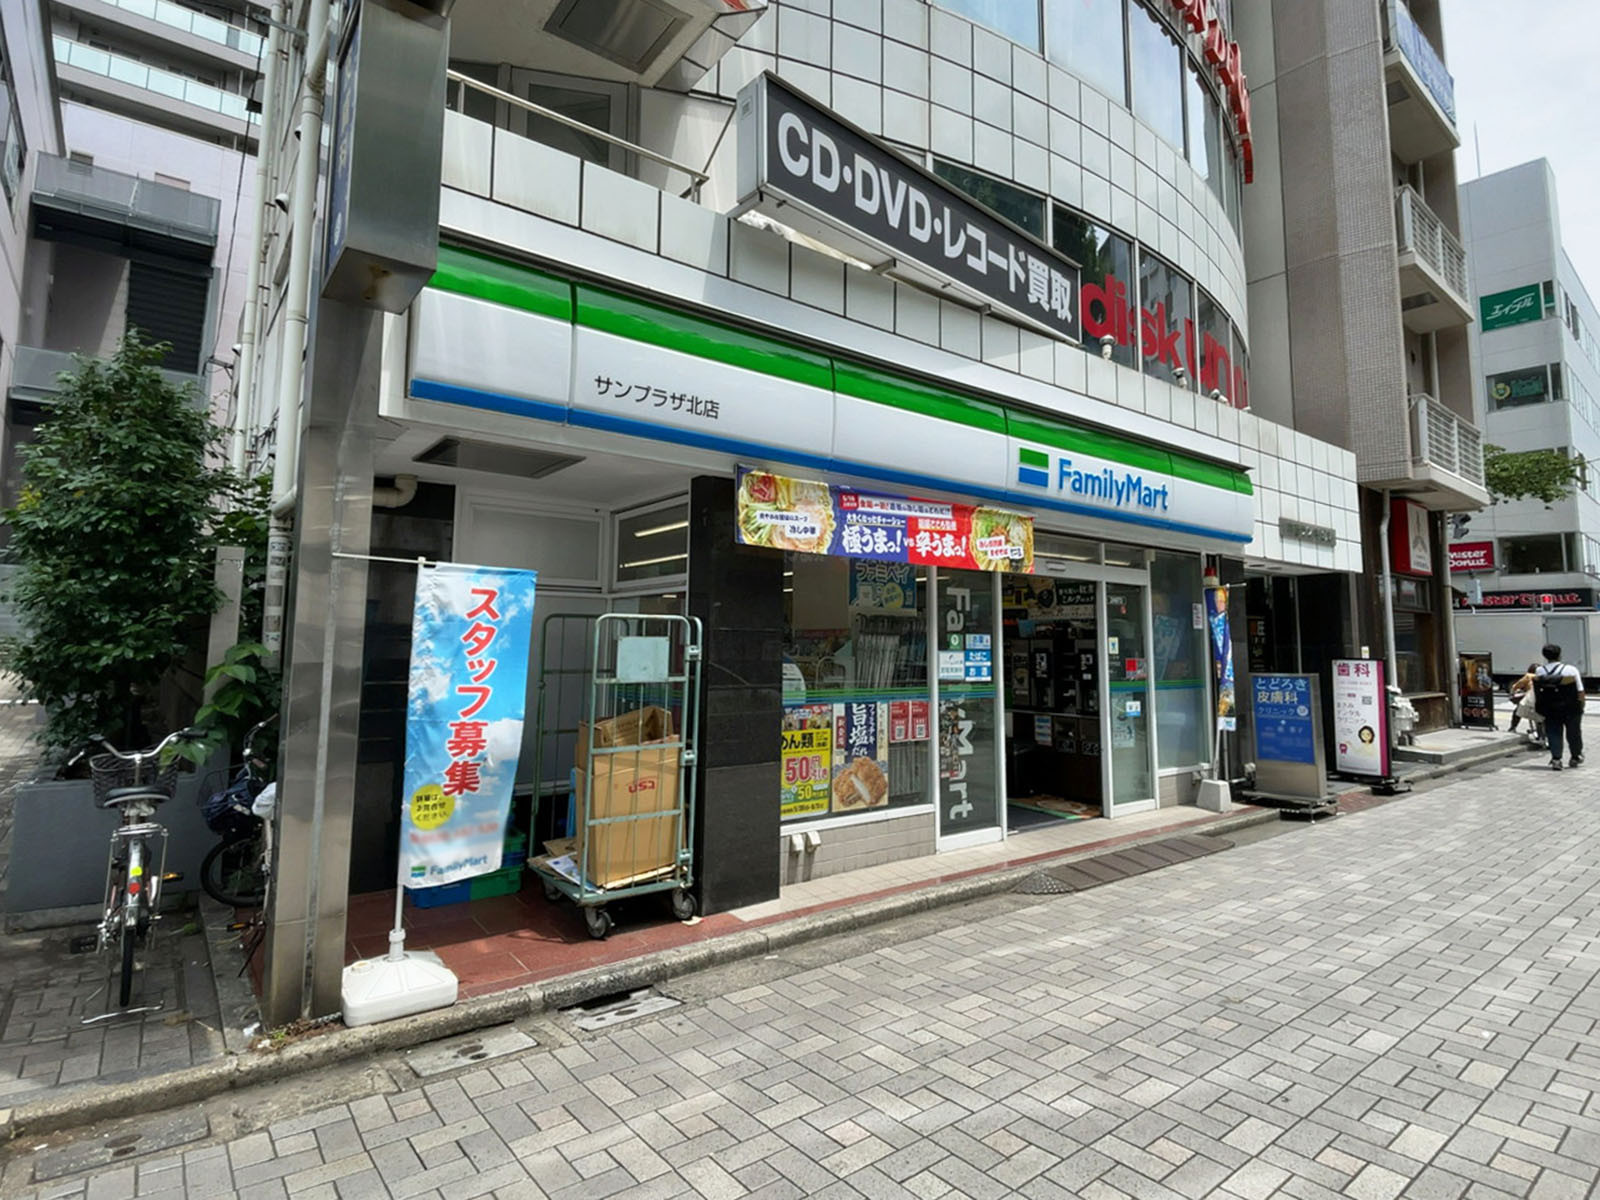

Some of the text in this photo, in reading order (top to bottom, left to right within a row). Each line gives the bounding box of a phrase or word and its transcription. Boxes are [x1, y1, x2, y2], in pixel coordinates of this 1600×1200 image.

[1485, 293, 1535, 320] エイブル
[594, 376, 720, 419] サンプラザ北店
[1059, 458, 1168, 510] FamilyMart
[441, 588, 500, 797] スタッフ募集
[1256, 677, 1307, 691] とどろき
[1257, 690, 1298, 704] 皮膚科
[430, 856, 488, 875] FamilyMart
